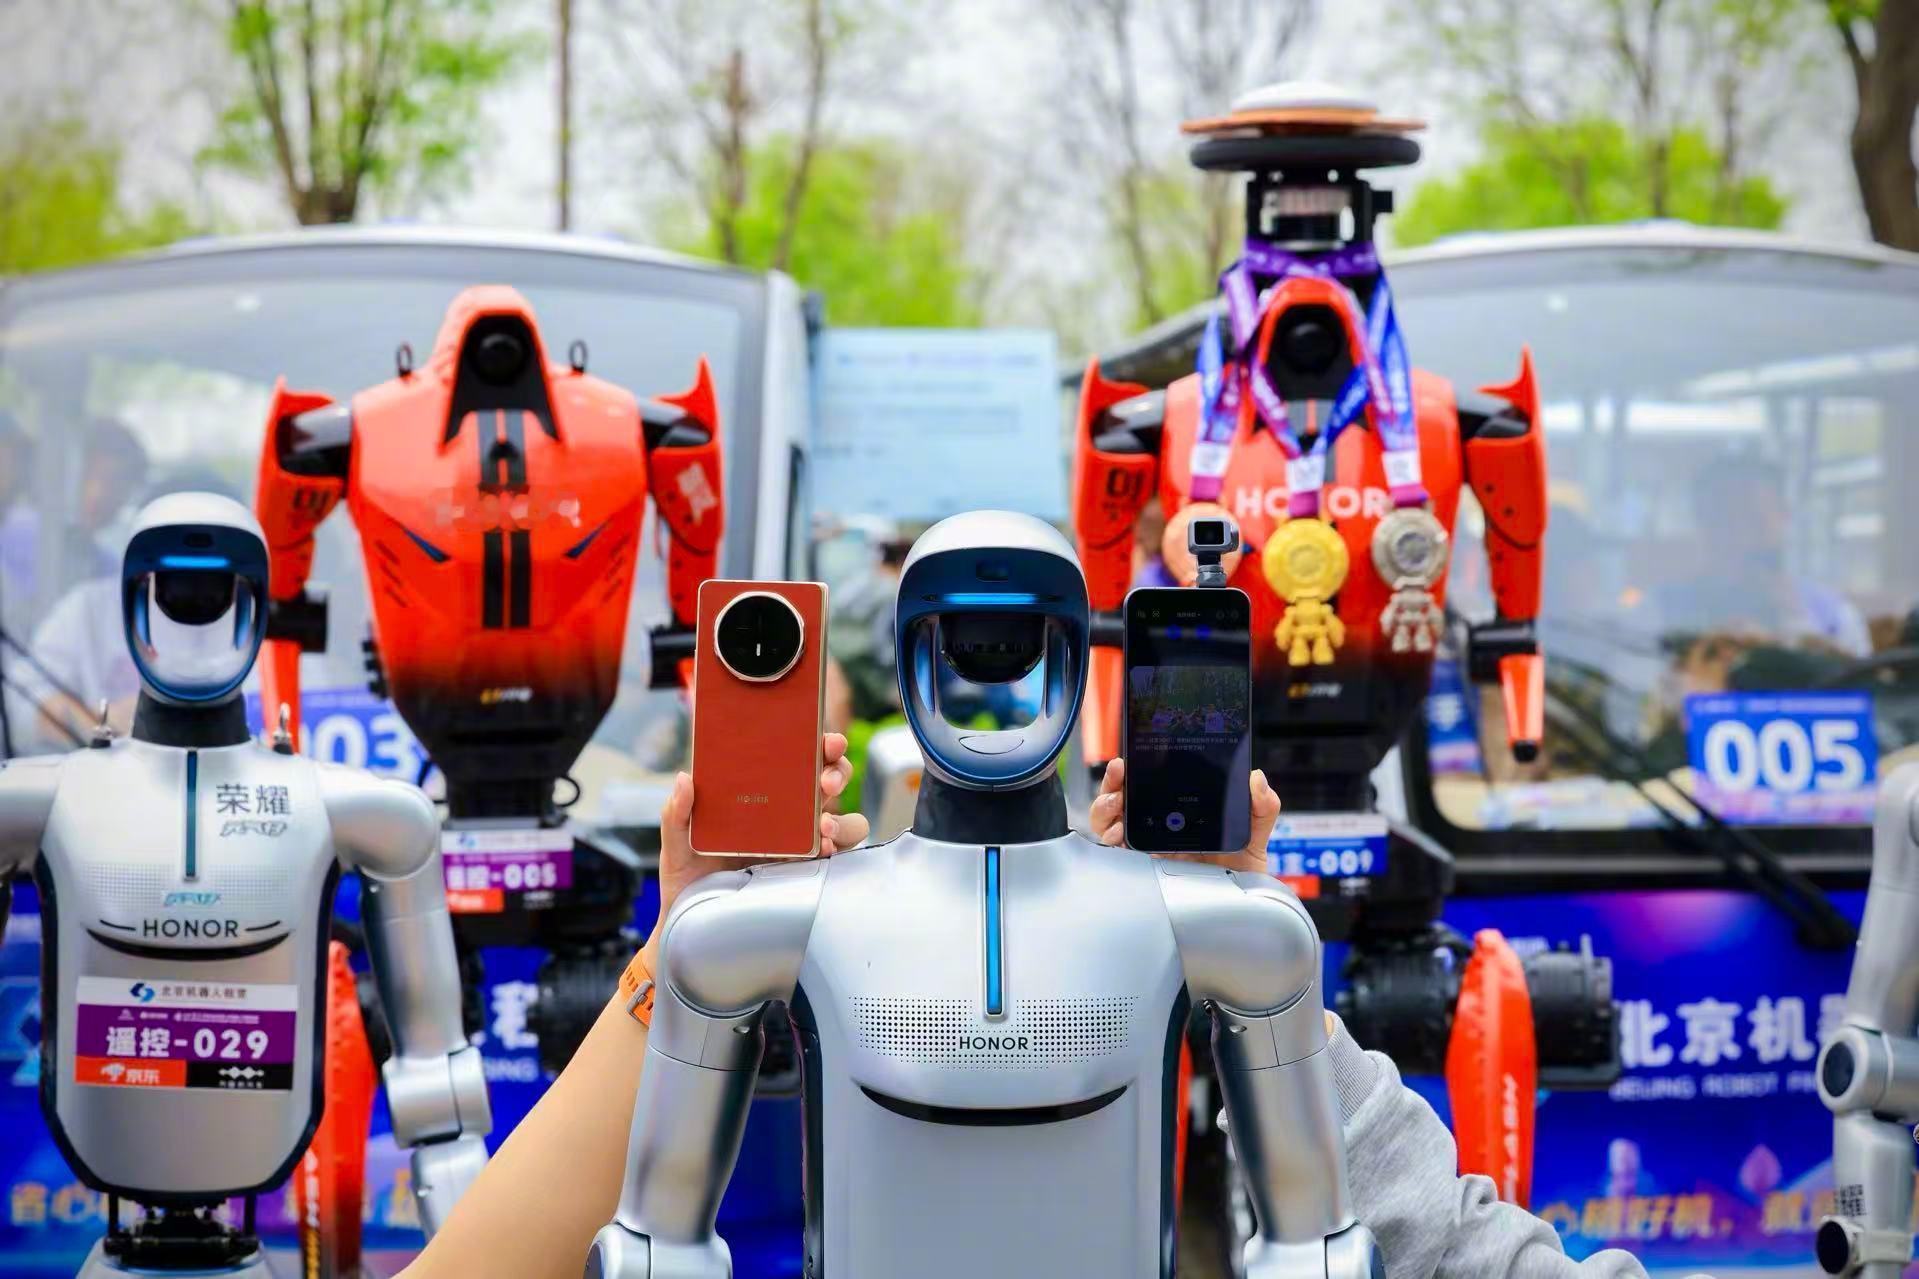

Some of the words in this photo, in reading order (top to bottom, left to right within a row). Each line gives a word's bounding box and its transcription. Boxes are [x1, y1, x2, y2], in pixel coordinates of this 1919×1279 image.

[1235, 486, 1390, 519] HOOR
[301, 713, 415, 781] 03
[1704, 718, 1866, 793] 005
[216, 784, 291, 815] 荣耀
[143, 919, 239, 938] HONOR
[106, 1026, 269, 1060] 遥控-029
[959, 1036, 1028, 1051] HONOR
